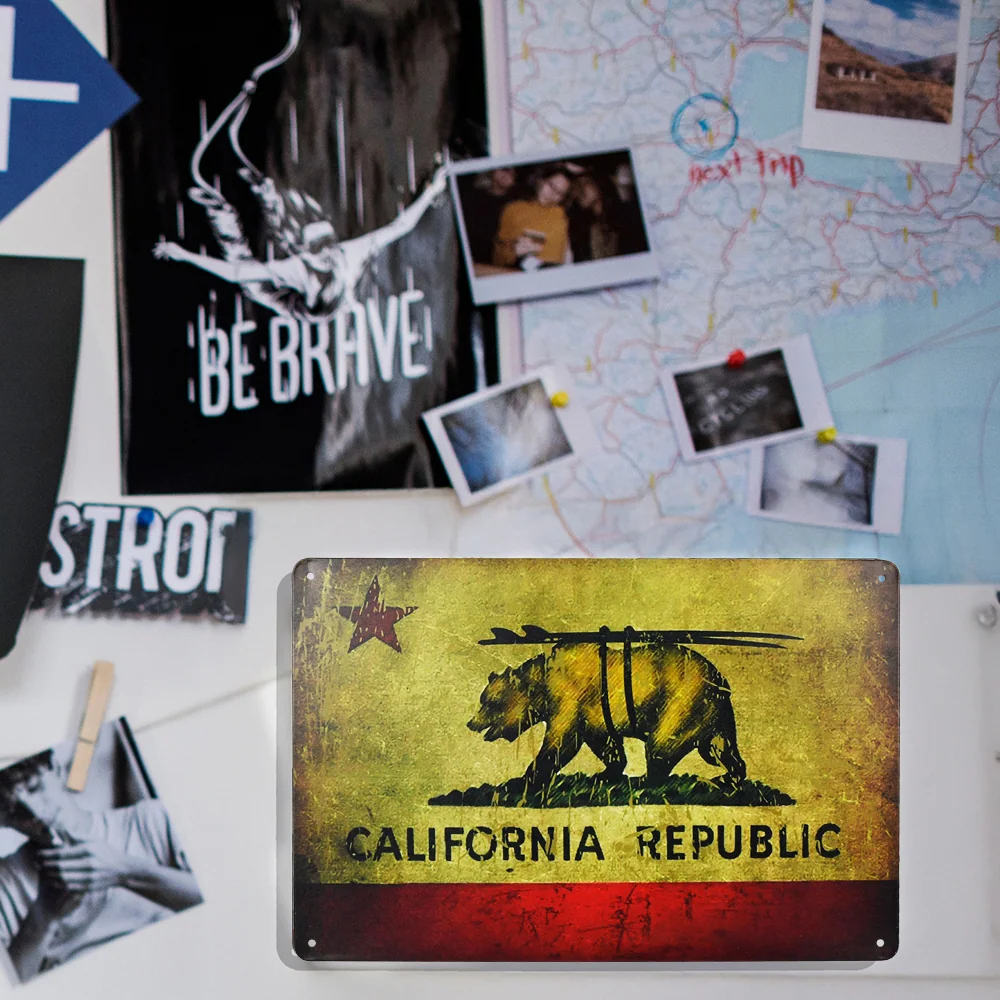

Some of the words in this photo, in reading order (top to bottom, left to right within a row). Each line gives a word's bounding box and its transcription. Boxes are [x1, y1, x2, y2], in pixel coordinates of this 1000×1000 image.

[688, 148, 742, 184] next
[756, 148, 806, 189] trip
[198, 303, 260, 417] BE
[268, 289, 430, 403] BRAVE
[344, 825, 606, 863] CALIFORNIA
[636, 822, 843, 861] REPUBLIC
